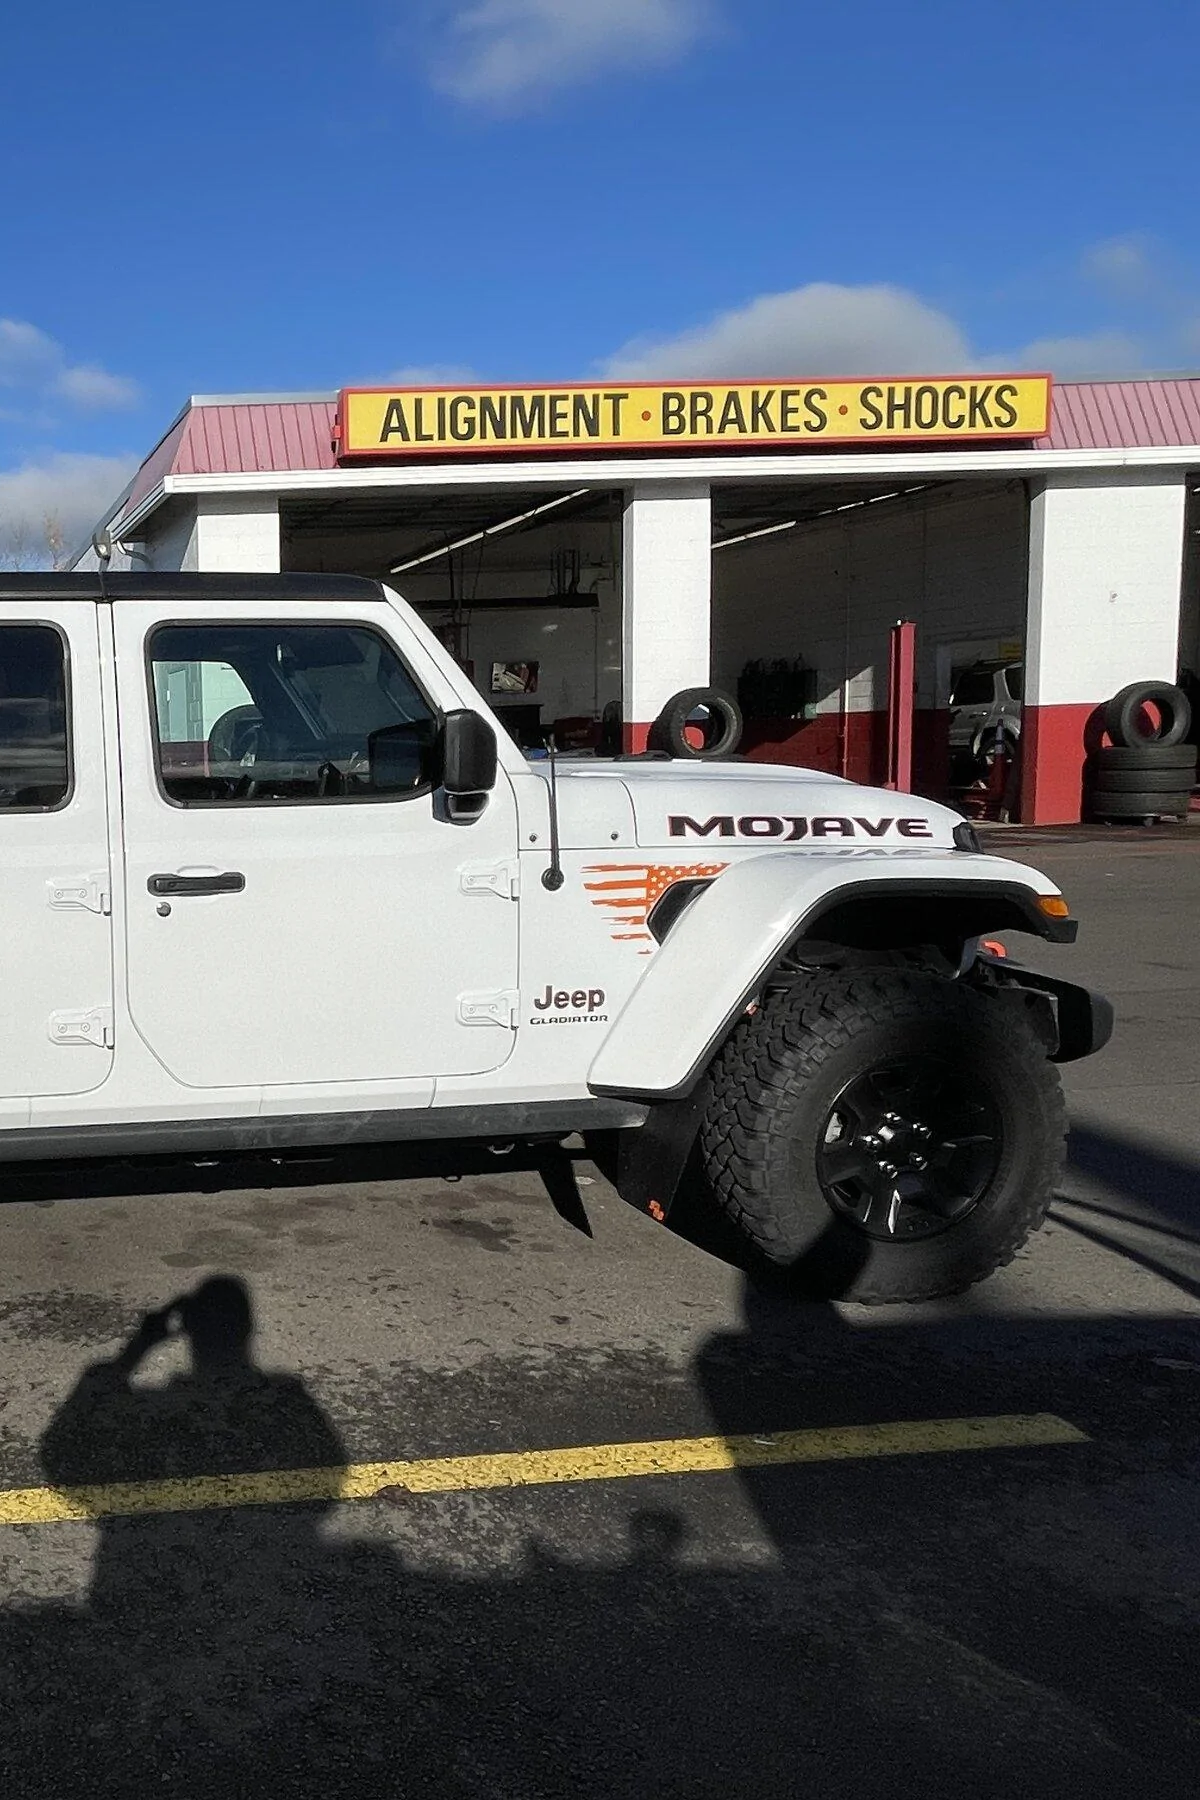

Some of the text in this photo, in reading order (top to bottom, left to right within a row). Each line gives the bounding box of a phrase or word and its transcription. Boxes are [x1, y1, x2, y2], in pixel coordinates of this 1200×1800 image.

[380, 384, 1018, 442] ALIGNMENT BRAKES SHOCKS
[668, 815, 933, 841] MOJAVE
[534, 985, 605, 1012] Jeep
[529, 1015, 608, 1025] GLADIATOR
